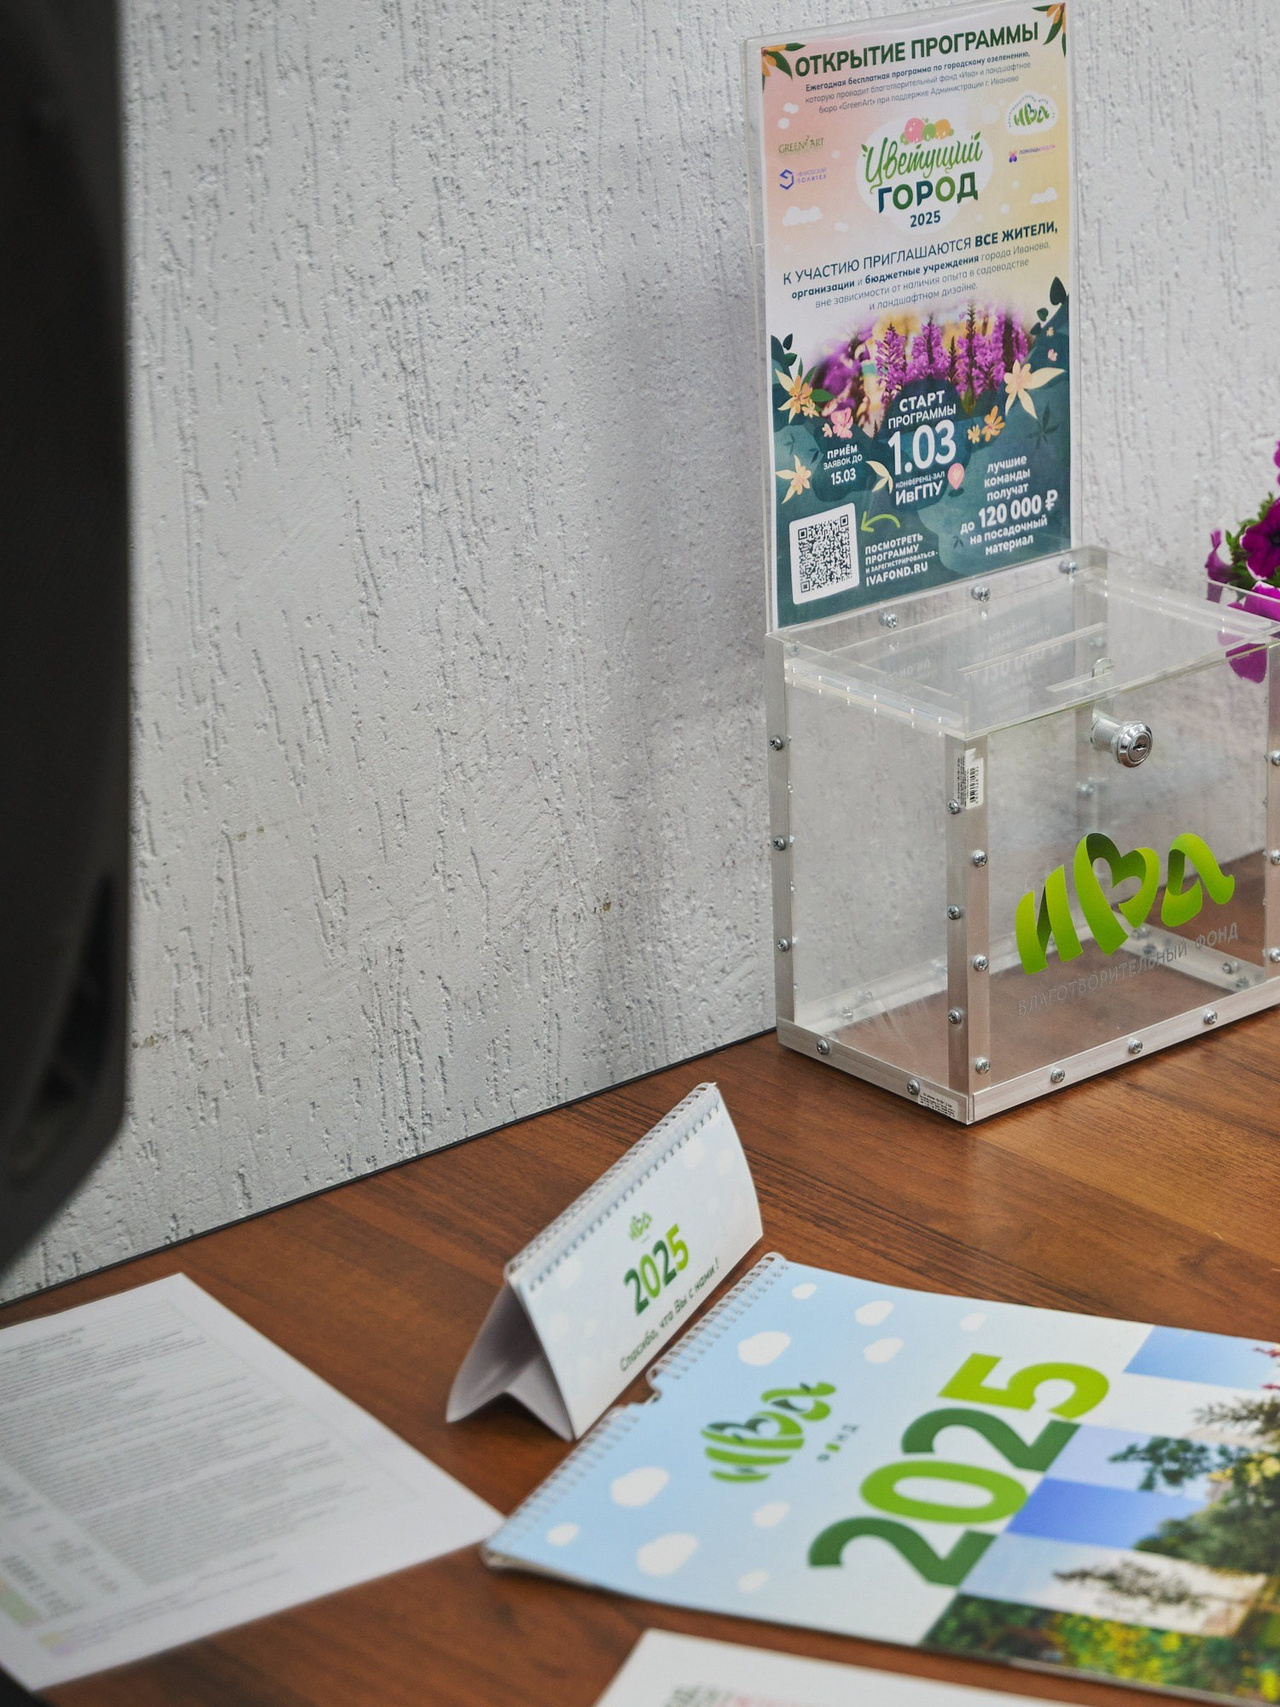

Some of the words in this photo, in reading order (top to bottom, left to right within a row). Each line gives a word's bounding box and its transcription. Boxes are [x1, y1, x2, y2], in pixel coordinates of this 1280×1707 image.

[795, 41, 906, 77] ОТКРЫТИЕ
[911, 21, 1039, 59] ПРОГРАММЫ
[805, 80, 847, 92] Ежегодная
[848, 72, 890, 85] бесплатная
[891, 66, 932, 80] программа
[944, 57, 985, 70] городскому
[986, 51, 1031, 63] озеленению,
[805, 93, 835, 104] которую
[836, 88, 869, 98] проводит
[870, 76, 938, 94] благотворительный
[940, 72, 958, 83] фонд
[985, 61, 1032, 75] ландшафтное
[819, 103, 838, 114] бюро
[876, 96, 890, 105] при
[890, 89, 929, 102] поддержке
[930, 81, 985, 96] Администрации
[990, 75, 1019, 86] Иваново
[865, 136, 983, 194] Цветущий
[877, 171, 979, 214] ГОРОД
[910, 210, 941, 228] 2025
[783, 272, 792, 285] К
[795, 259, 860, 282] УЧАСТИЮ
[863, 237, 971, 269] ПРИГЛАШАЮТСЯ
[975, 232, 999, 248] ВСЕ
[1001, 220, 1058, 242] ЖИТЕЛИ,
[791, 280, 855, 301] организации
[857, 278, 863, 286] и
[865, 267, 921, 285] бюджетные
[922, 255, 979, 275] учреждения
[981, 248, 1012, 263] города
[1013, 241, 1051, 255] Иваново,
[815, 298, 832, 308] вне
[833, 287, 890, 305] зависимости
[891, 283, 901, 293] от
[902, 275, 940, 290] наличия
[942, 270, 968, 283] опыта
[976, 258, 1030, 275] садоводстве
[869, 302, 875, 310] и
[876, 290, 940, 310] ландшафтном
[940, 281, 978, 298] дизайне.
[899, 390, 946, 412] СТАРТ
[888, 404, 957, 429] ПРОГРАММЫ
[823, 456, 851, 470] ЗАЯВОК
[852, 453, 863, 465] ДО
[827, 444, 858, 459] ПРИЁМ
[887, 419, 957, 476] 1.03
[830, 467, 857, 486] 15.03
[984, 468, 1031, 488] команды
[986, 455, 1028, 474] лучшие
[895, 471, 946, 489] КОНФЕРЕНЦ-ЗАЛ
[895, 480, 943, 506] ИвГПУ
[986, 483, 1029, 502] получат
[960, 521, 976, 536] до
[978, 502, 1008, 528] 120
[1010, 494, 1042, 520] 000
[969, 533, 983, 545] на
[984, 514, 1048, 541] посадочный
[865, 532, 924, 555] ПОСМОТРЕТЬ
[865, 543, 920, 566] ПРОГРАММУ
[985, 534, 1034, 556] материал
[865, 561, 929, 587] IVAFOND.RU
[1018, 940, 1187, 1017] БЛАГОТВОРИТЕЛЬНЫЙ
[1194, 922, 1240, 949] ФОНД
[623, 1222, 689, 1317] 2025
[619, 1330, 659, 1372] Спасибо,
[659, 1310, 674, 1329] что
[674, 1293, 688, 1315] Вы
[695, 1265, 715, 1293] нами
[807, 1352, 1110, 1587] 2025
